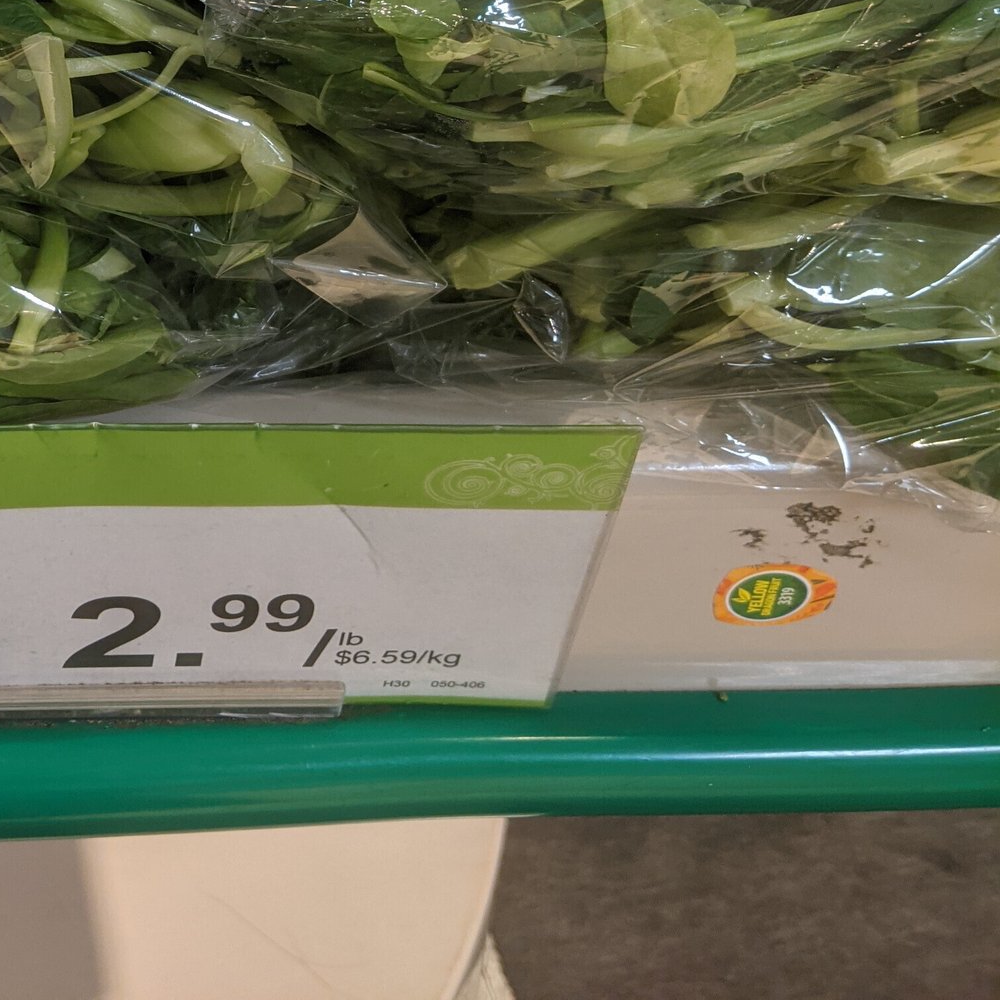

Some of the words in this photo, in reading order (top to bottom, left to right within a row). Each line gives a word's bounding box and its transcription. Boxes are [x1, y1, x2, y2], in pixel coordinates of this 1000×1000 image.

[747, 580, 770, 613] YELLOW
[777, 587, 796, 605] 3319
[334, 649, 462, 669] $6.59/kg
[383, 680, 411, 688] H30
[430, 680, 486, 689] 050-406
